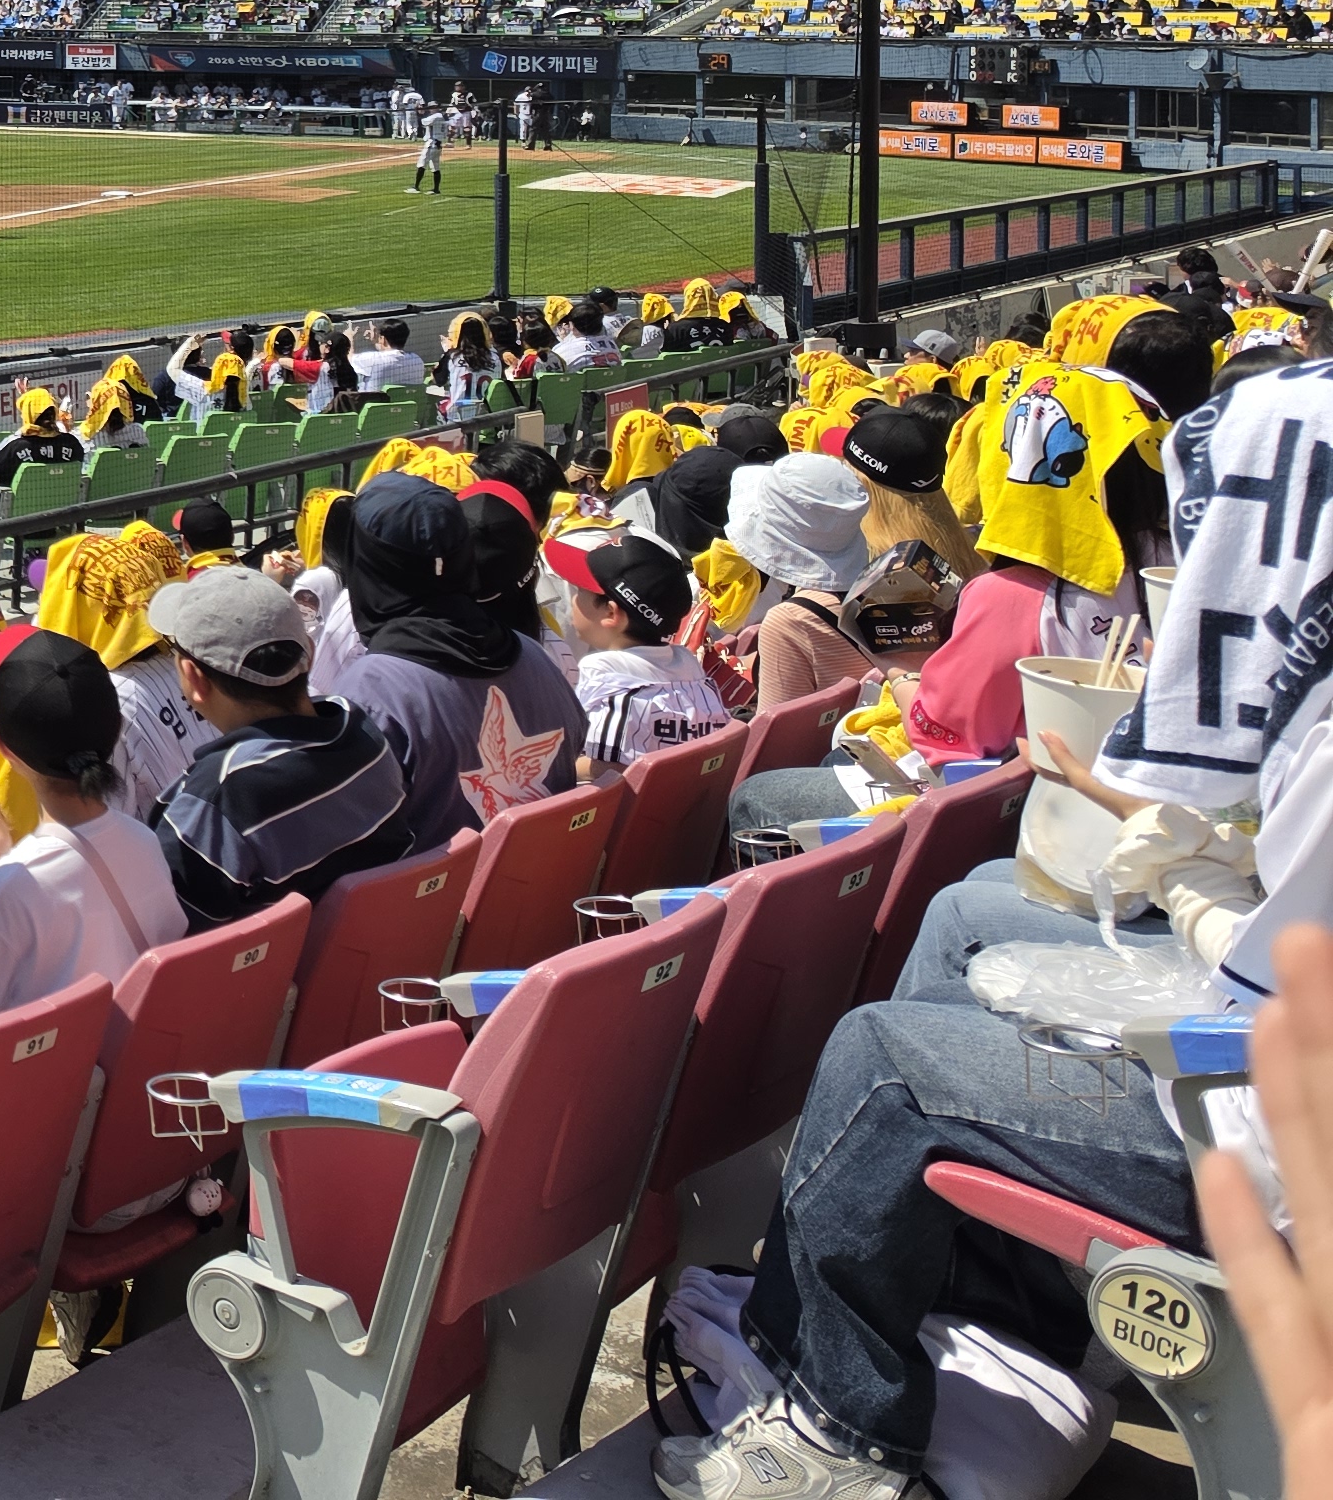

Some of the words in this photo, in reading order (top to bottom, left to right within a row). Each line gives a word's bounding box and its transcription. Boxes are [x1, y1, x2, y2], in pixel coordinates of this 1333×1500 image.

[970, 46, 977, 56] B
[1010, 47, 1018, 57] H
[70, 56, 112, 69] 두산밥캣
[237, 56, 264, 67] 신한
[295, 58, 331, 68] KBO
[331, 56, 361, 68] 리그
[510, 54, 599, 74] IBK캐피탈
[970, 59, 976, 69] S
[1010, 60, 1017, 71] E
[1006, 72, 1019, 82] FC
[901, 136, 940, 153] 노페로
[1065, 143, 1106, 164] 로와콜
[15, 444, 74, 463] 박해민
[614, 581, 664, 627] LGE.COM
[708, 757, 720, 771] 87
[424, 877, 441, 894] 89
[848, 870, 864, 890] 93
[242, 949, 261, 966] 90
[652, 961, 674, 983] 92
[24, 1036, 46, 1053] 91
[1119, 1280, 1191, 1331] 120
[1111, 1316, 1189, 1367] BLOCK
